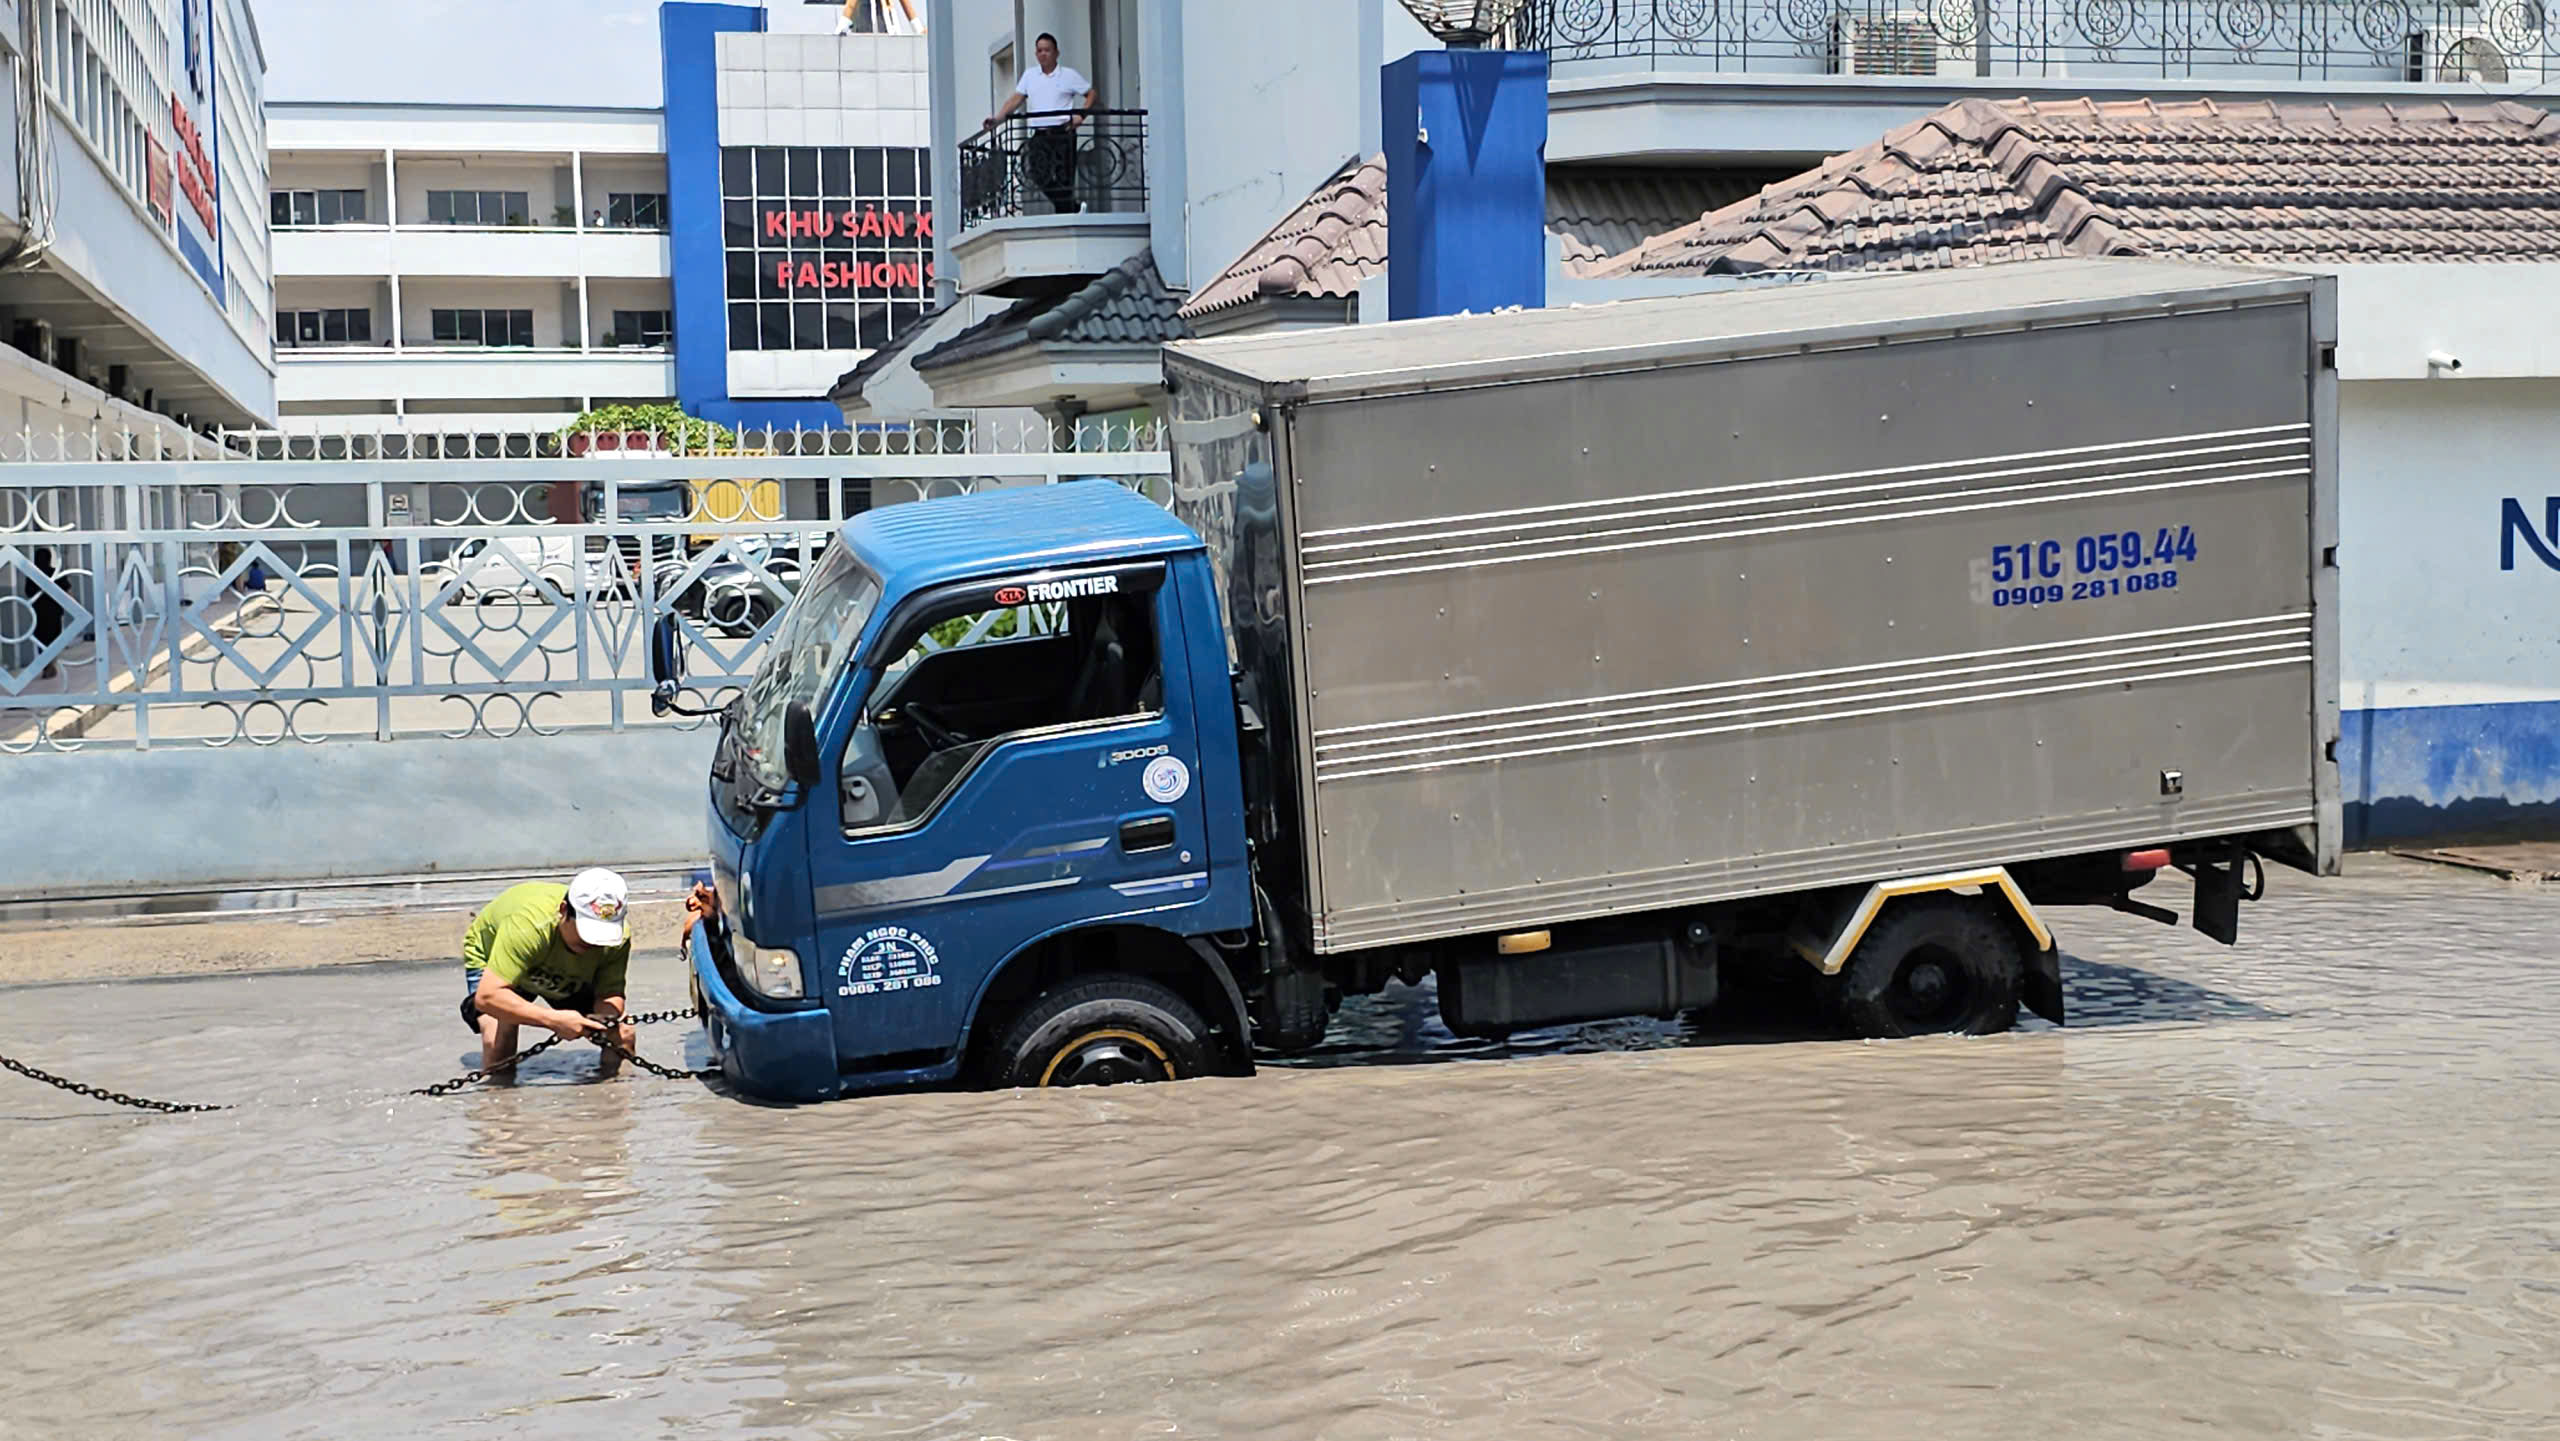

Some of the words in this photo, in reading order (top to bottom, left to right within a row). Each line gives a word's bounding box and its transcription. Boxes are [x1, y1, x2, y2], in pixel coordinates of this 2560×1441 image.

[765, 210, 835, 238] KHU
[842, 203, 904, 238] SẢN
[777, 261, 920, 288] FASHION
[1991, 540, 2061, 582] 51C
[2076, 525, 2198, 574] 059.44
[998, 589, 1023, 603] KIA
[1027, 575, 1119, 602] FRONTIER
[1992, 584, 2064, 607] 0909
[2071, 578, 2120, 601] 281
[2126, 570, 2178, 593] 088
